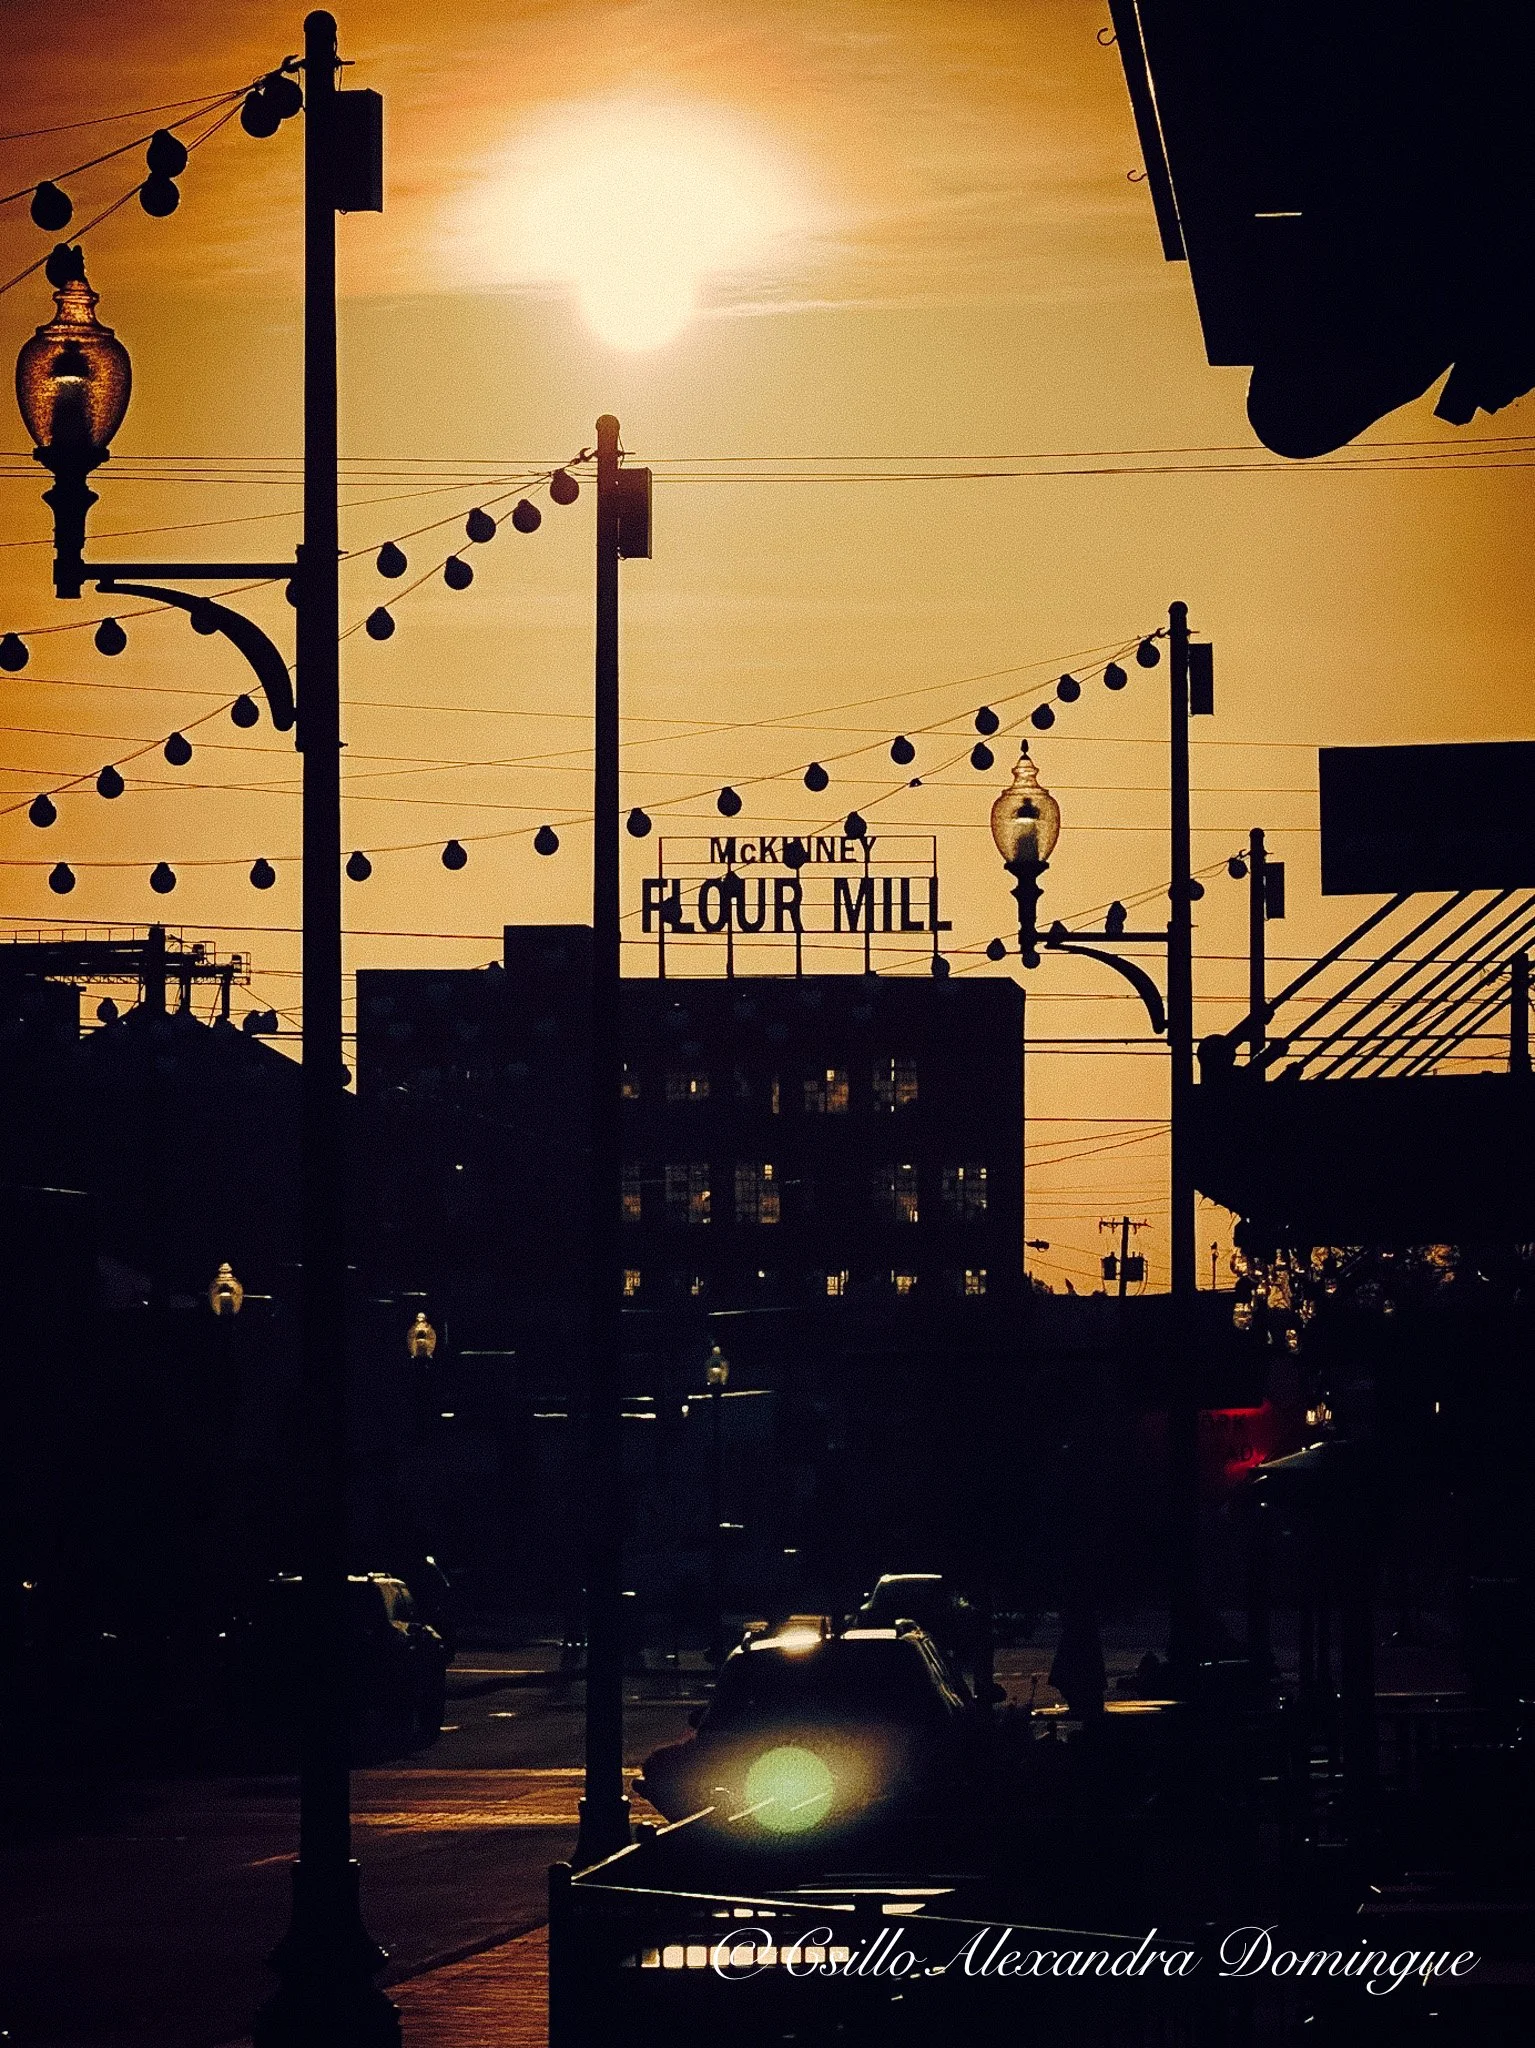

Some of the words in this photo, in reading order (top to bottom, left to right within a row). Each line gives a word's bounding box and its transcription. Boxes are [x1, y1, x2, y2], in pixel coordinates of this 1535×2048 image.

[710, 836, 877, 864] McKINNEY
[642, 878, 804, 933] FLOUR
[834, 877, 952, 932] MILL
